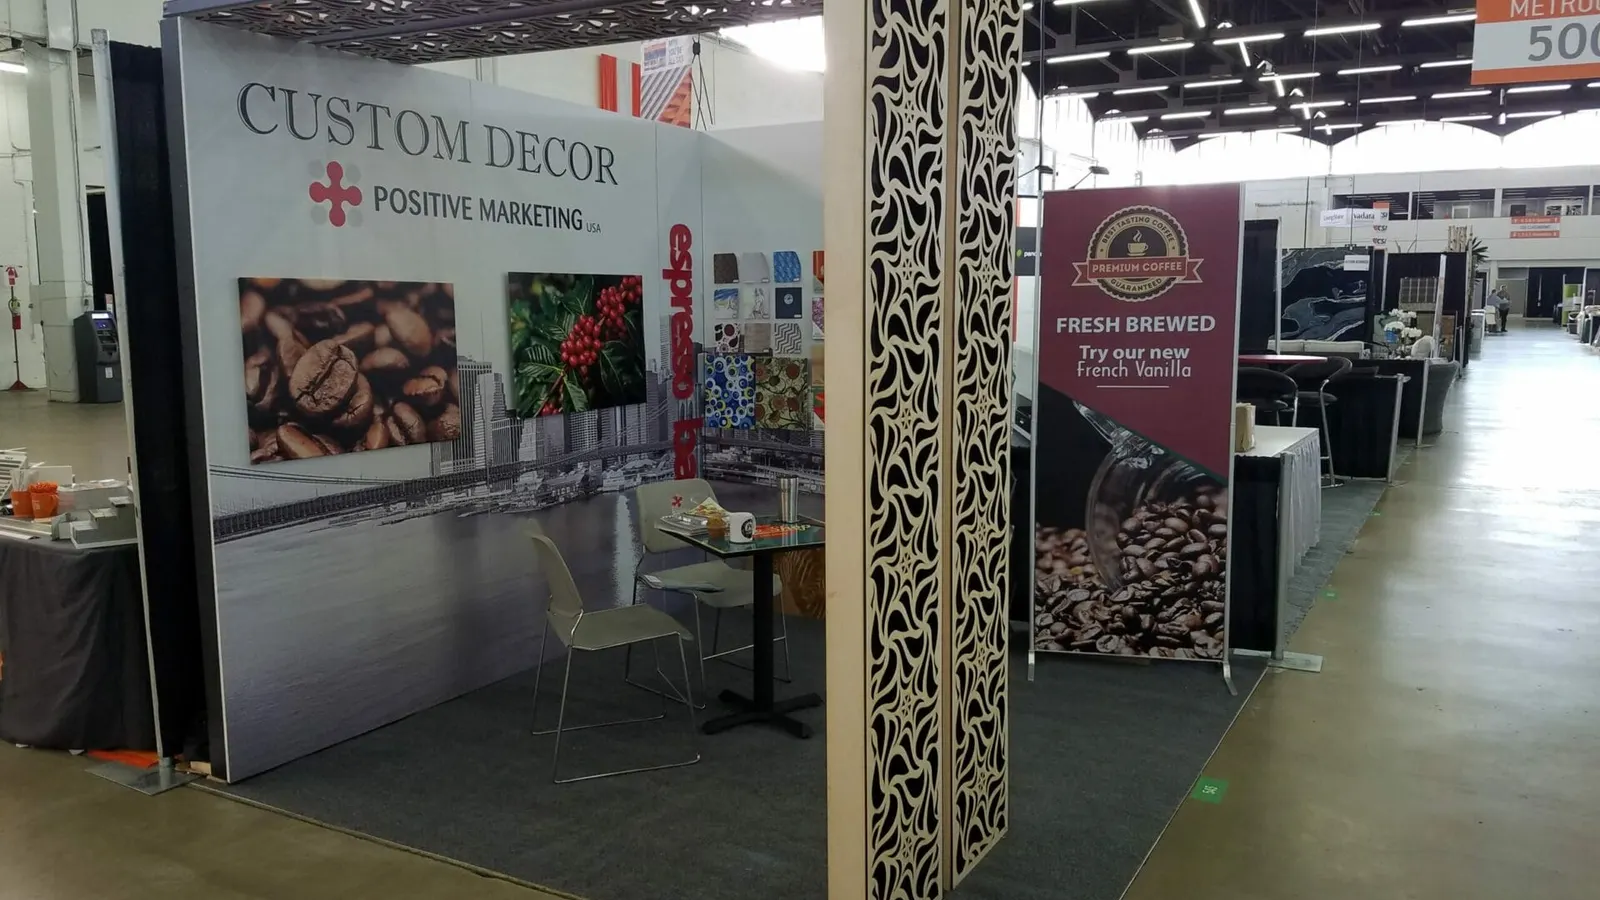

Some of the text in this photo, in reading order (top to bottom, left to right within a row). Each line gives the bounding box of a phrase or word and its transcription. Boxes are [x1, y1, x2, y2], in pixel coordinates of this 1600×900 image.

[236, 82, 619, 185] CUSTOM DECOR
[374, 186, 602, 233] POSITIVE MARKETING USA
[1101, 216, 1175, 244] BEST TASTING COFFEE
[1092, 261, 1182, 273] PREMIUM COFFEE
[1110, 278, 1162, 292] GUARANTEED
[662, 224, 694, 399] espresso
[1056, 315, 1216, 334] FRESH BREWED
[1079, 345, 1190, 363] Try our new
[1077, 359, 1191, 378] French Vanilla
[674, 417, 704, 480] ba
